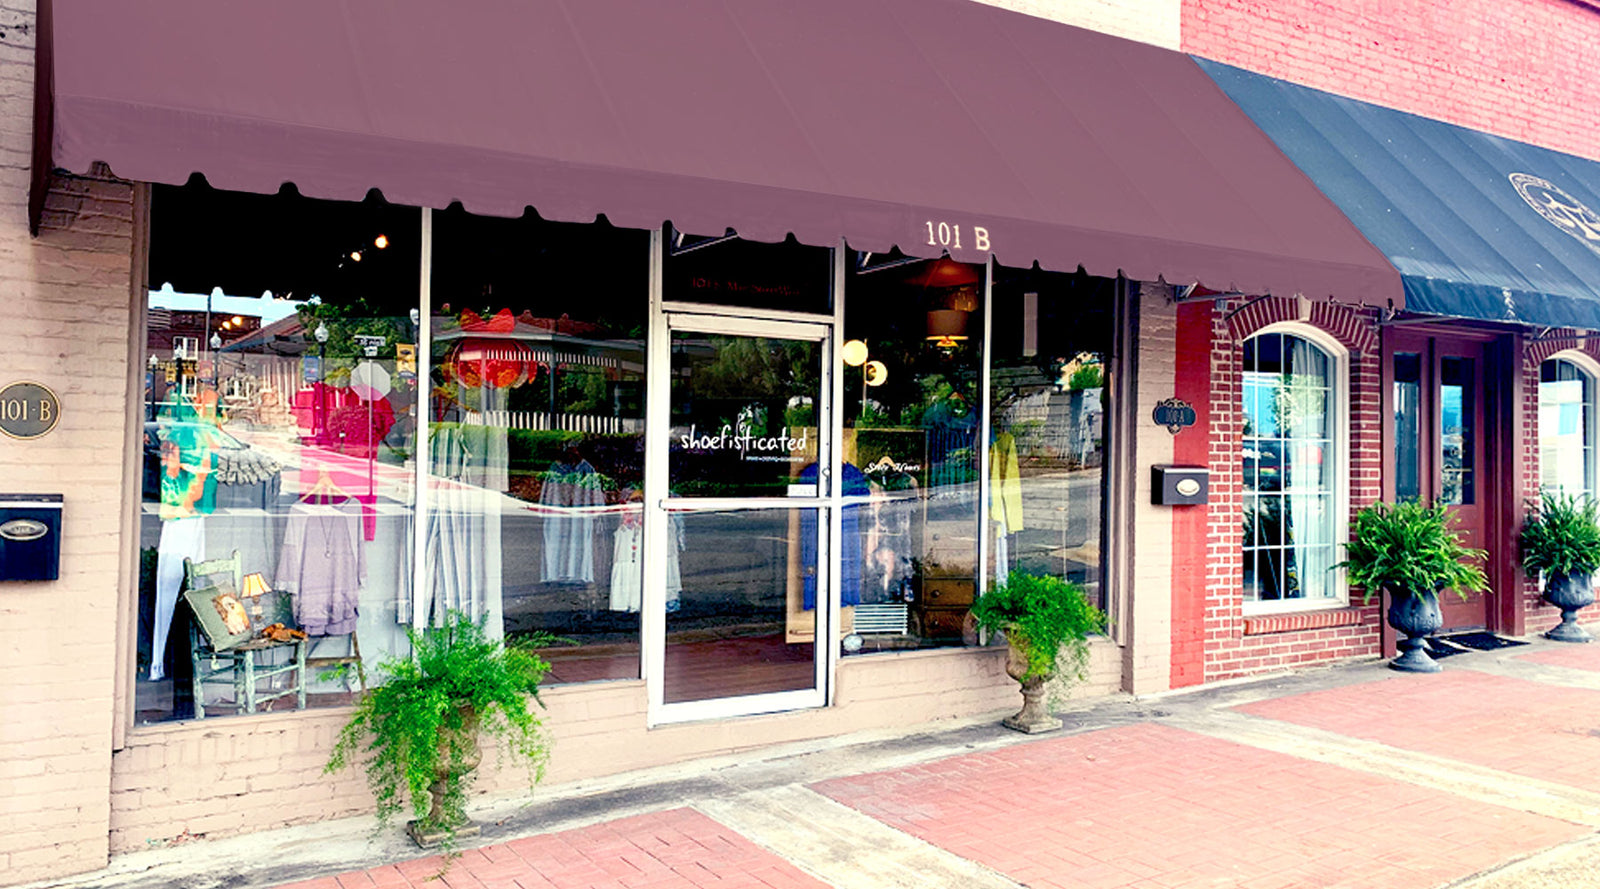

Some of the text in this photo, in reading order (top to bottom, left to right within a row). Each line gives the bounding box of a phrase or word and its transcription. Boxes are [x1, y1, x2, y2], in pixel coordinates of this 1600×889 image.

[925, 221, 991, 251] 101 B
[681, 424, 807, 452] shoefisticated
